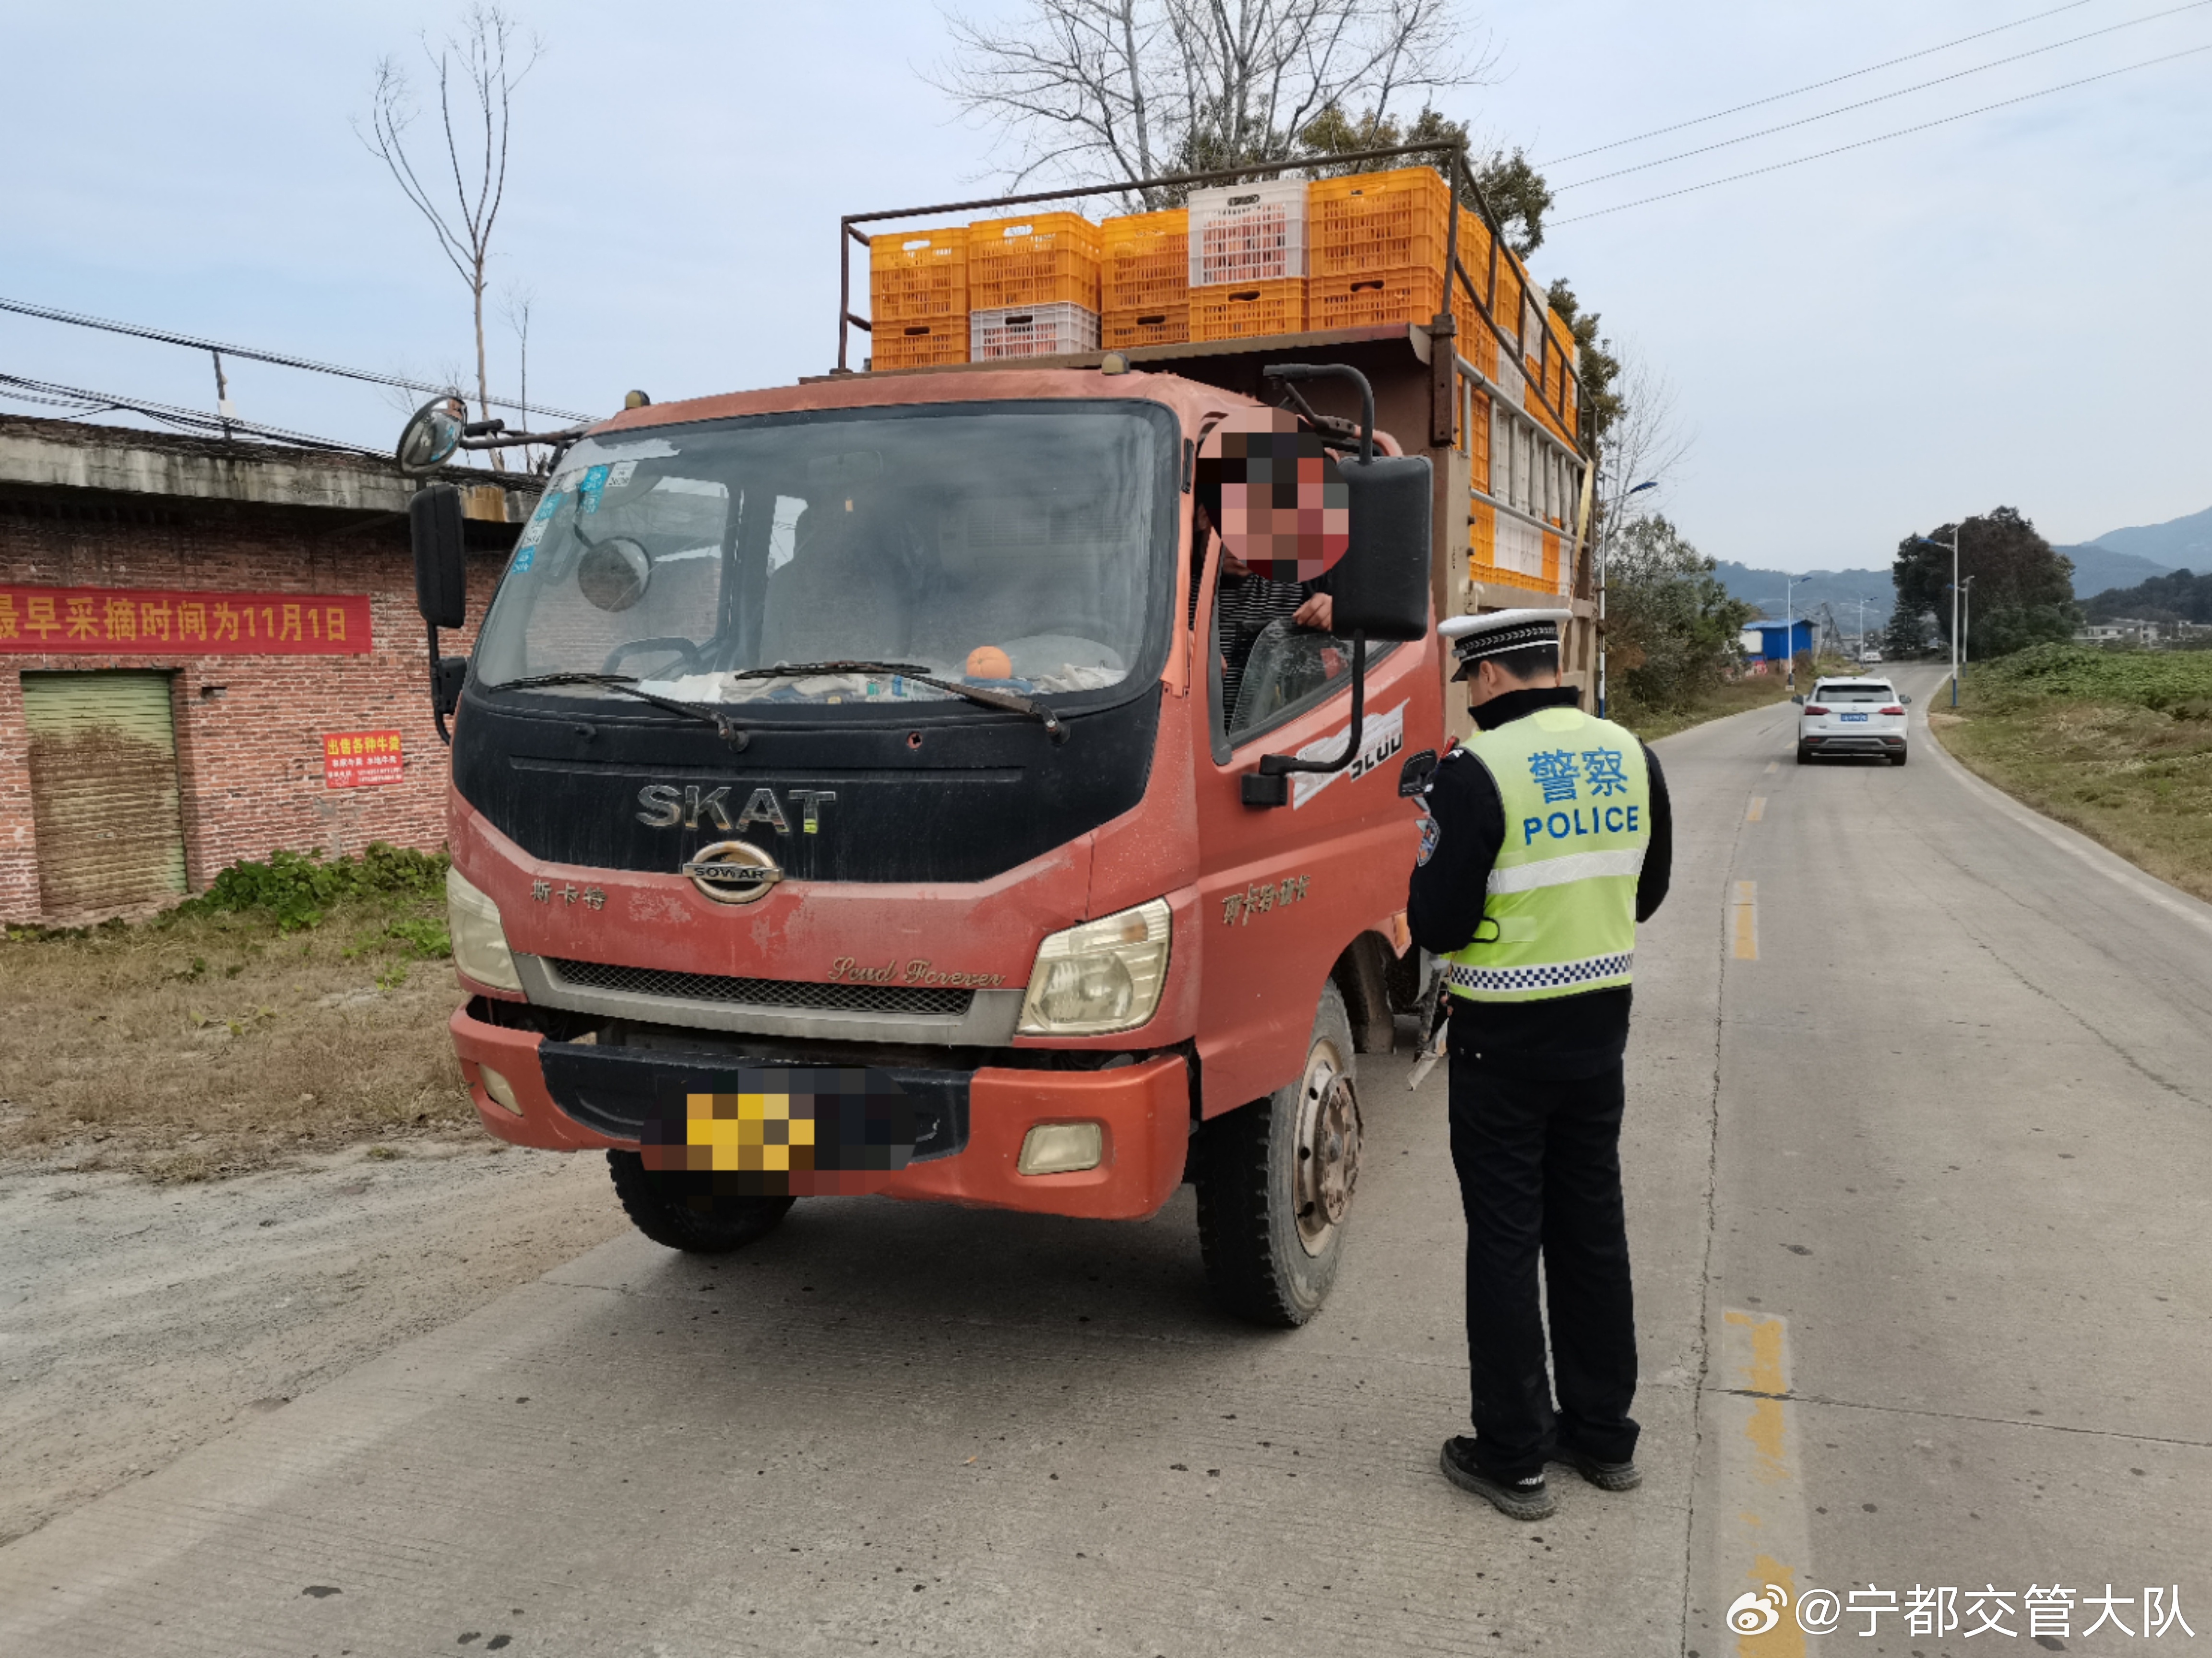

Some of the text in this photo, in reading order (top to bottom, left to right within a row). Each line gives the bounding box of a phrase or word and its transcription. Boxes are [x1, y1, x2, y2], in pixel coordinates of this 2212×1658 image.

[1527, 746, 1628, 805] 警察
[635, 785, 836, 834] SKAT
[1523, 805, 1639, 846] POLICE
[694, 867, 766, 879] SOWAR
[530, 879, 607, 911] 斯卡特
